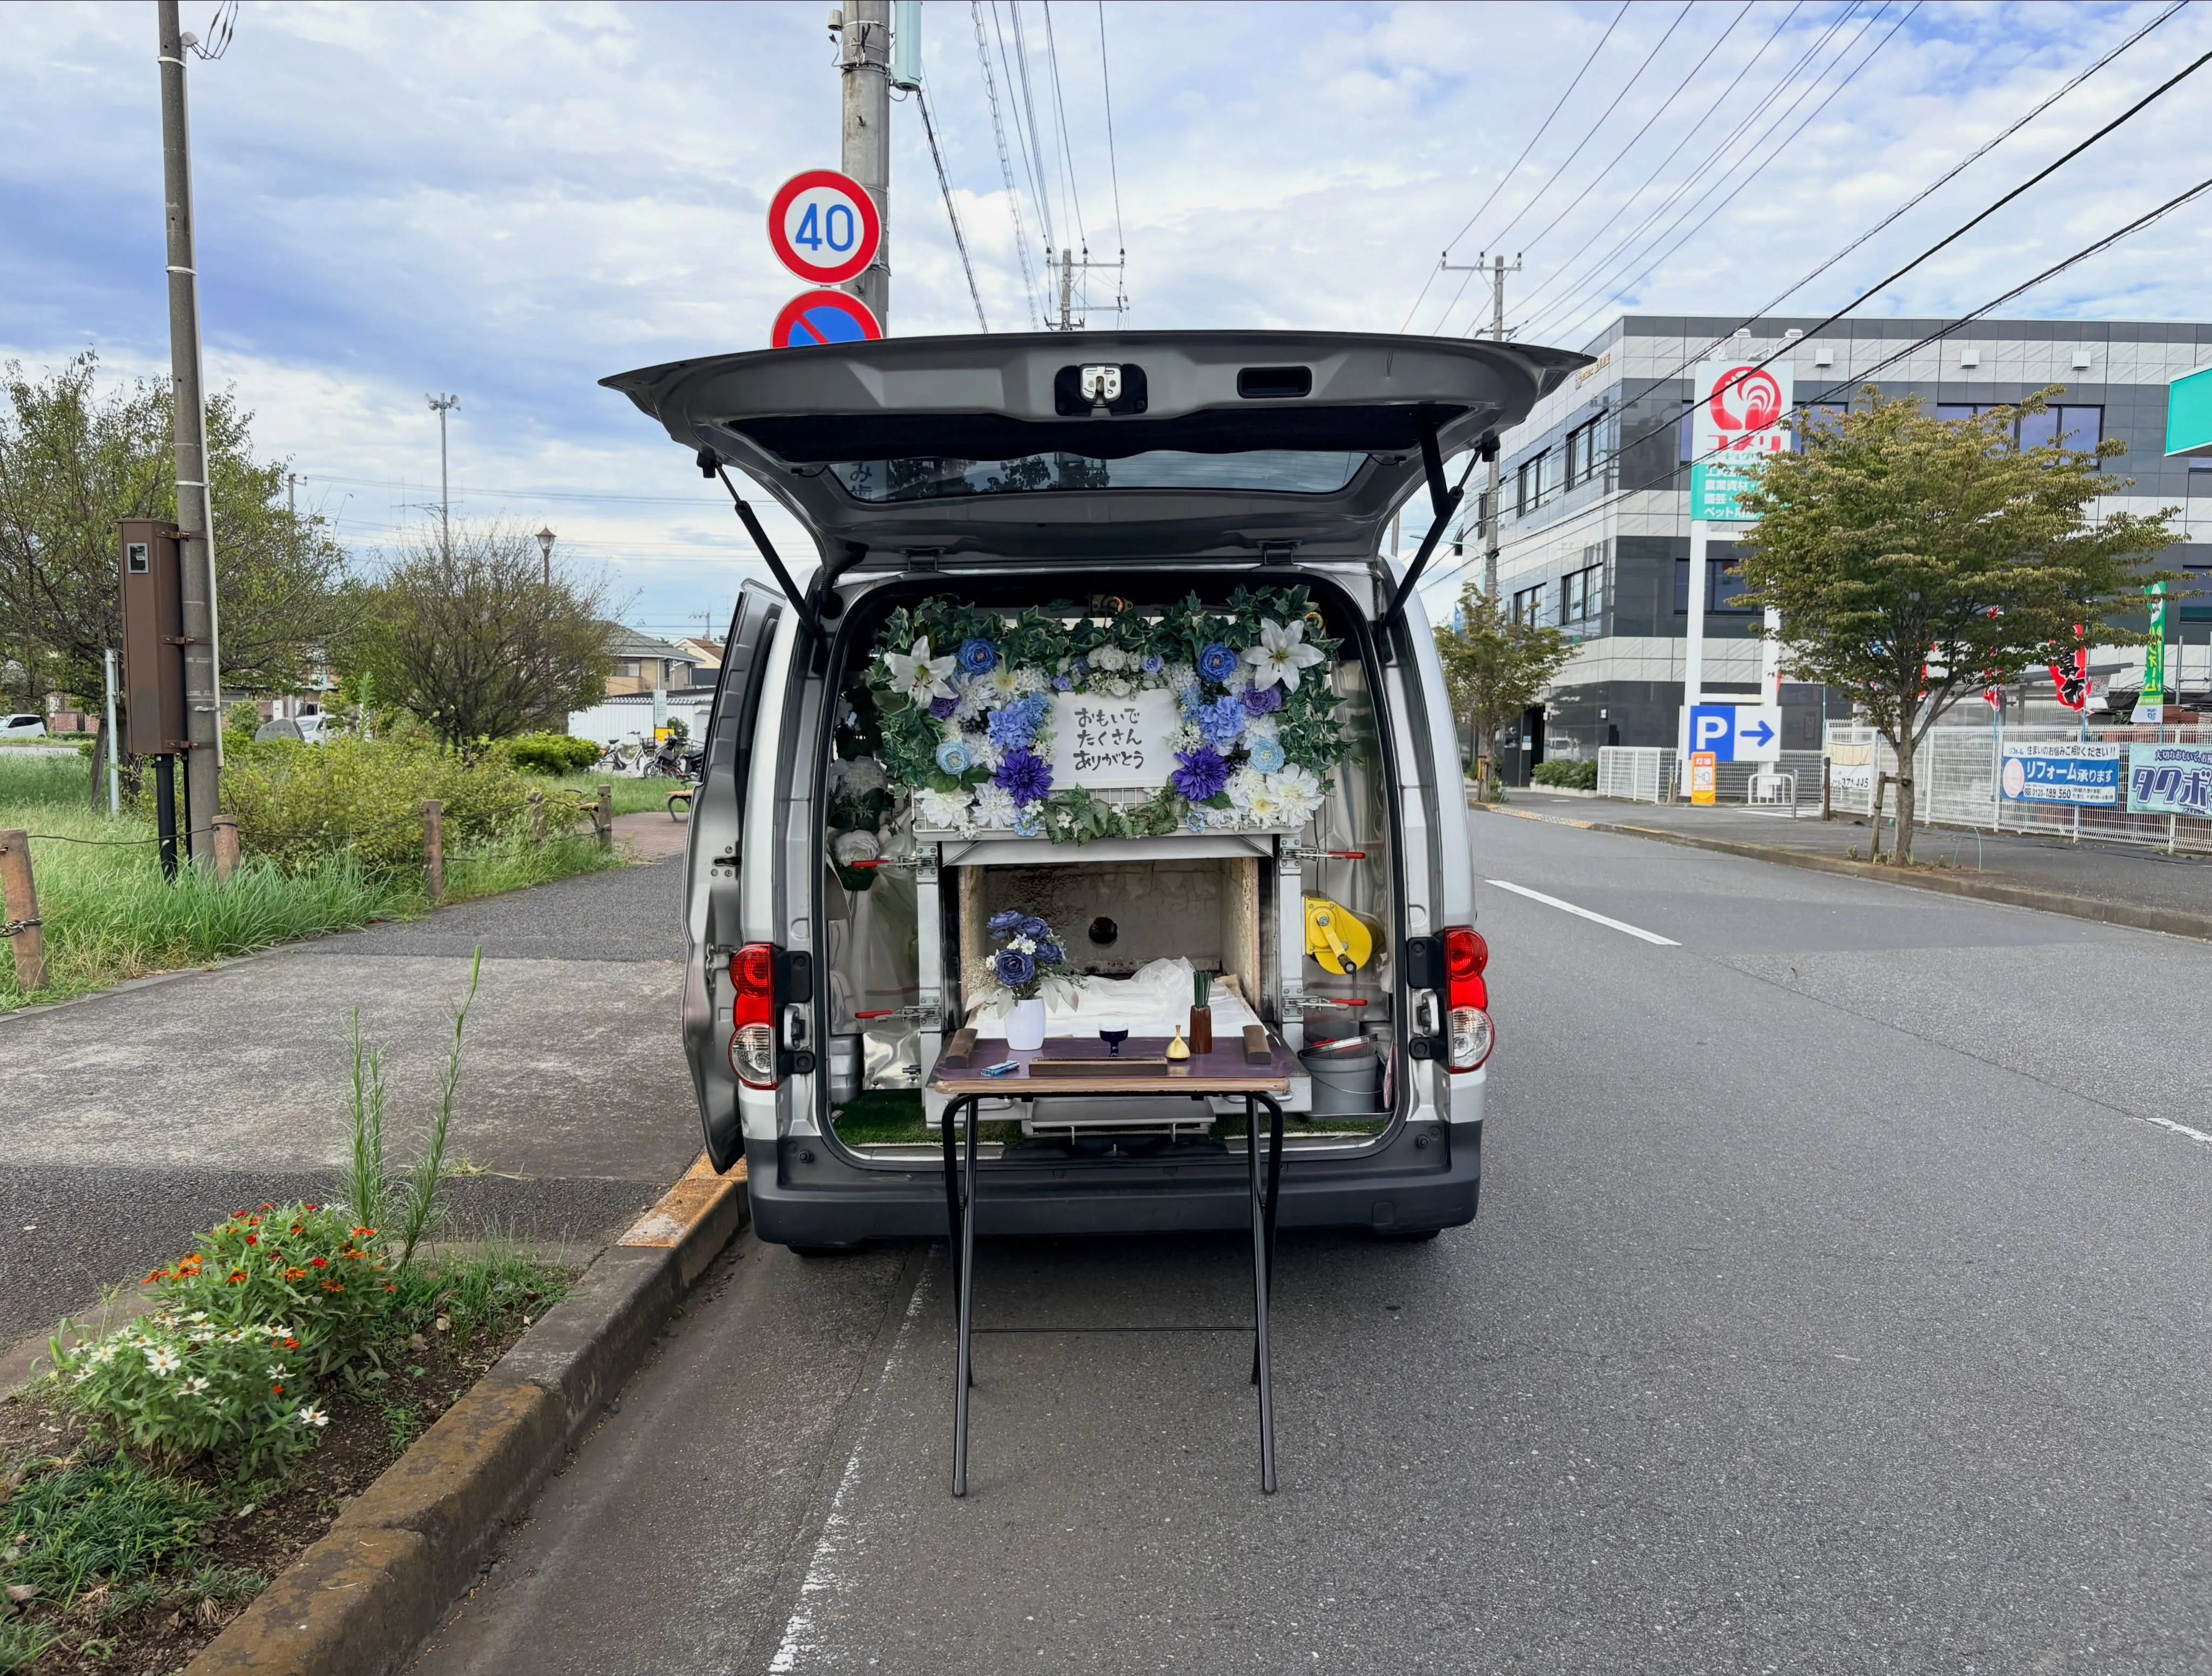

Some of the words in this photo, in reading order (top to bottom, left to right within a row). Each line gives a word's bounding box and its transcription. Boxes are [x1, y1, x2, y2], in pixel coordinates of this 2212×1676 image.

[795, 203, 854, 252] 40
[1707, 435, 1781, 451] コメリ
[1075, 708, 1139, 728] おもいで
[1077, 728, 1142, 748] たくさん
[1696, 716, 1728, 750] P
[1073, 750, 1144, 771] ありがとう
[2027, 760, 2113, 783] リフォーム承ります
[2132, 765, 2212, 810] タクボ
